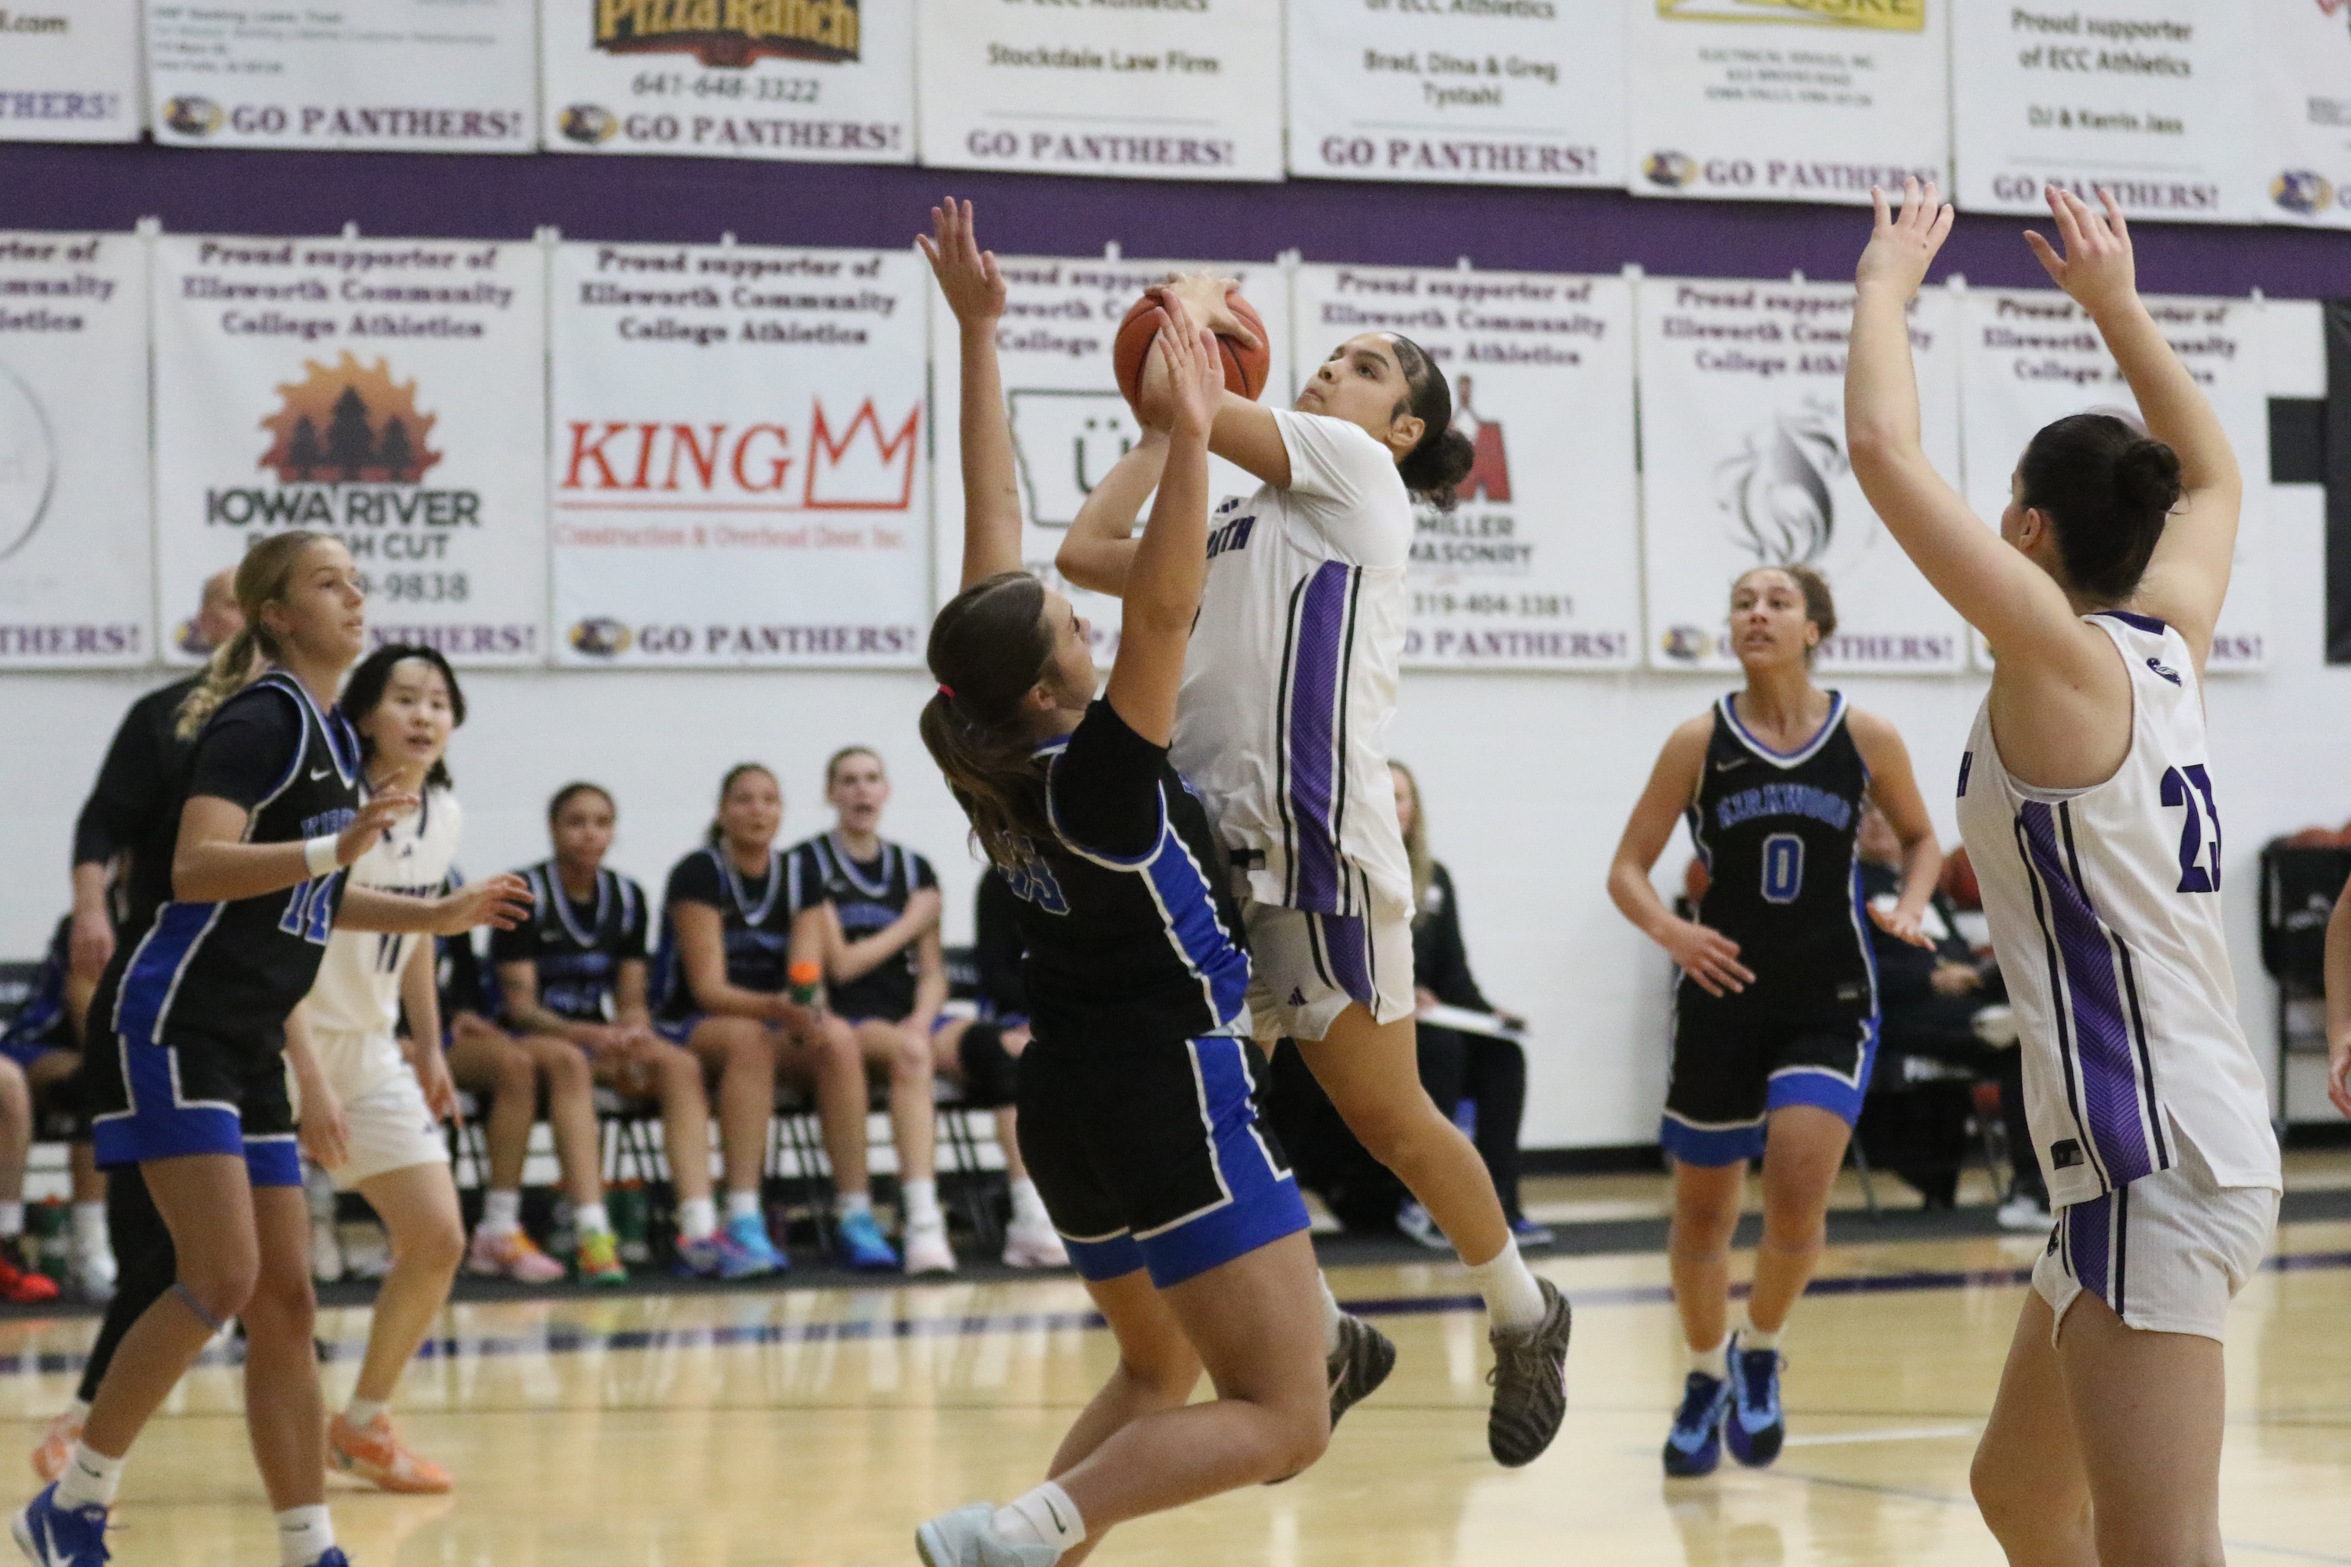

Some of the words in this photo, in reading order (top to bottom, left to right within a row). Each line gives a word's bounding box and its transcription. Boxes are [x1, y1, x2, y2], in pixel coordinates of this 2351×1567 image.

[2011, 7, 2080, 35] Proud
[2087, 17, 2193, 42] supporter
[986, 43, 1103, 69] Stockdale
[1109, 49, 1159, 72] Law
[1165, 51, 1221, 74] Firm
[2018, 47, 2042, 69] of
[2048, 47, 2090, 72] ECC
[2097, 49, 2192, 78] Athletics
[231, 104, 287, 135] GO
[302, 106, 523, 140] PANTHERS!
[624, 114, 680, 142] GO
[693, 117, 900, 149] PANTHERS!
[966, 130, 1018, 158] GO
[1030, 133, 1235, 165] PANTHERS!
[1321, 137, 1375, 167] GO
[1386, 139, 1600, 175] PANTHERS!
[1704, 156, 1755, 186] GO
[1993, 173, 2037, 201] GO
[200, 243, 293, 265] Proud
[304, 248, 456, 271] supporter
[467, 246, 498, 269] of
[598, 249, 687, 272] Proud
[699, 256, 842, 280] supporter
[853, 256, 882, 278] of
[183, 275, 330, 299] Ellsworth
[340, 280, 515, 310] Community
[580, 282, 721, 307] Ellsworth
[731, 287, 897, 317] Community
[1336, 270, 1417, 294] Proud
[1426, 278, 1556, 304] supporter
[1564, 281, 1592, 303] of
[1676, 286, 1755, 308] Proud
[221, 311, 336, 340] College
[350, 315, 483, 339] Athletics
[1321, 302, 1447, 328] Ellsworth
[1455, 307, 1608, 337] Community
[1998, 299, 2074, 319] Proud
[2202, 304, 2230, 326] of
[618, 316, 729, 346] College
[739, 322, 869, 346] Athletics
[1662, 316, 1783, 343] Ellsworth
[1982, 327, 2098, 351] Ellsworth
[1465, 341, 1581, 367] Athletics
[1694, 350, 1787, 378] College
[2013, 359, 2101, 385] College
[560, 420, 793, 494] KING
[206, 487, 333, 527] IOWA
[346, 489, 481, 527] RIVER
[1415, 514, 1515, 538] MILLER
[383, 532, 449, 560] CUT
[639, 624, 694, 653] GO
[706, 626, 916, 657] PANTHERS!
[1433, 630, 1627, 660] PANTHERS!
[1760, 832, 1806, 904] 0
[277, 870, 340, 946] 14
